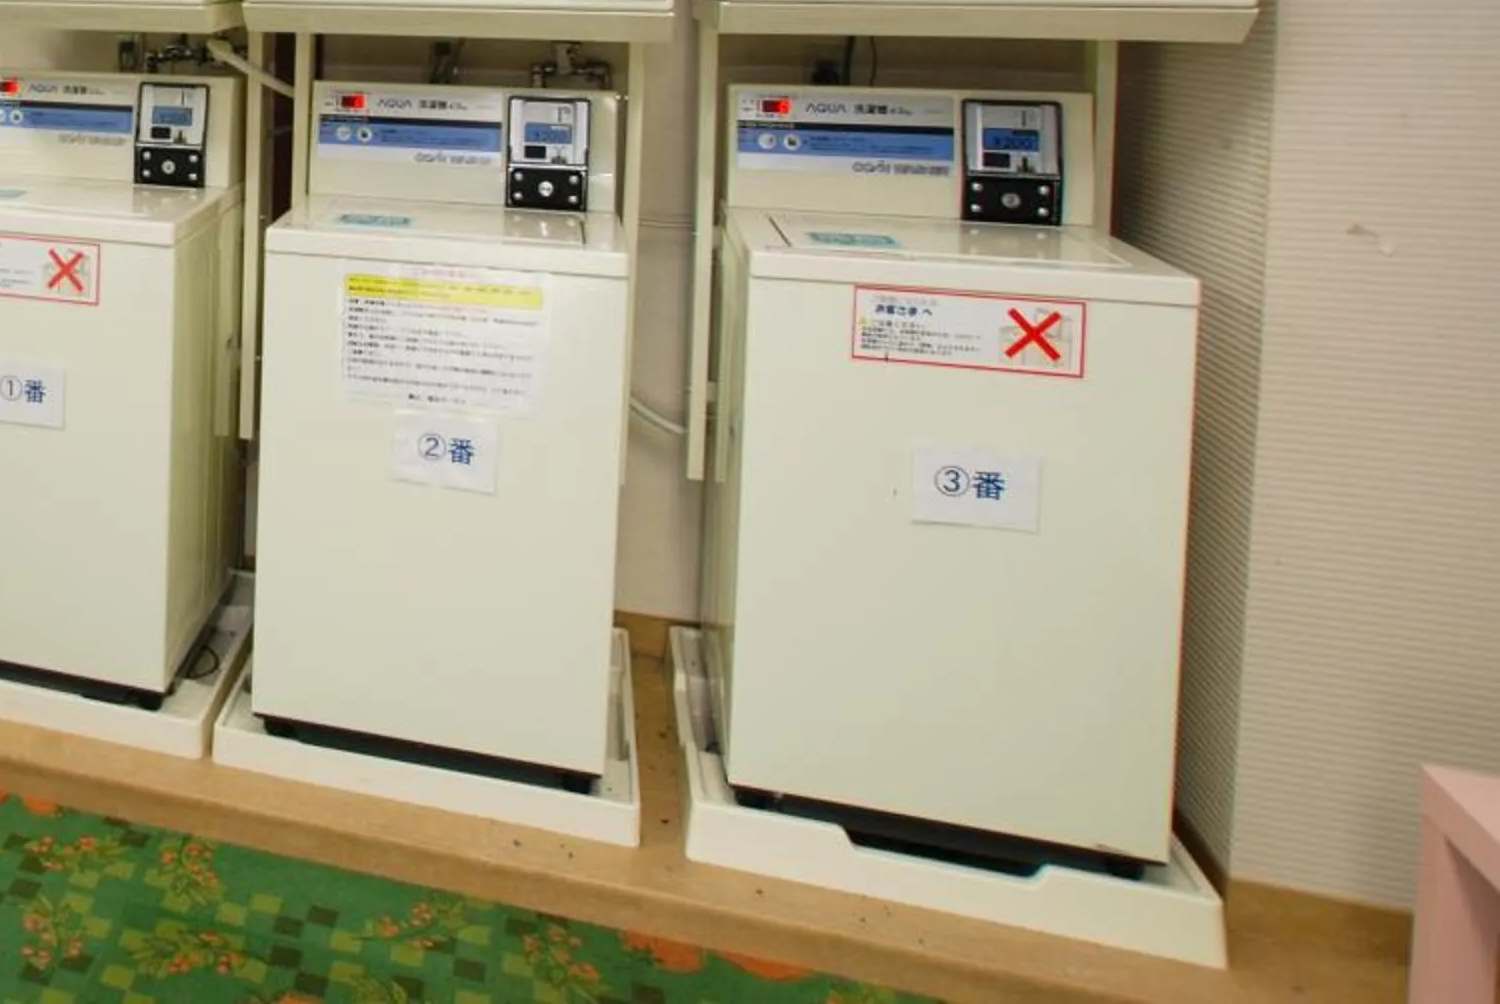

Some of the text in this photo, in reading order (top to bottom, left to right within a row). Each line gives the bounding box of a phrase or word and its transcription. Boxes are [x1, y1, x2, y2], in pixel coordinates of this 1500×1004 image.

[804, 102, 847, 114] AQUA
[417, 433, 476, 466] ②番
[933, 464, 1006, 501] ③番
